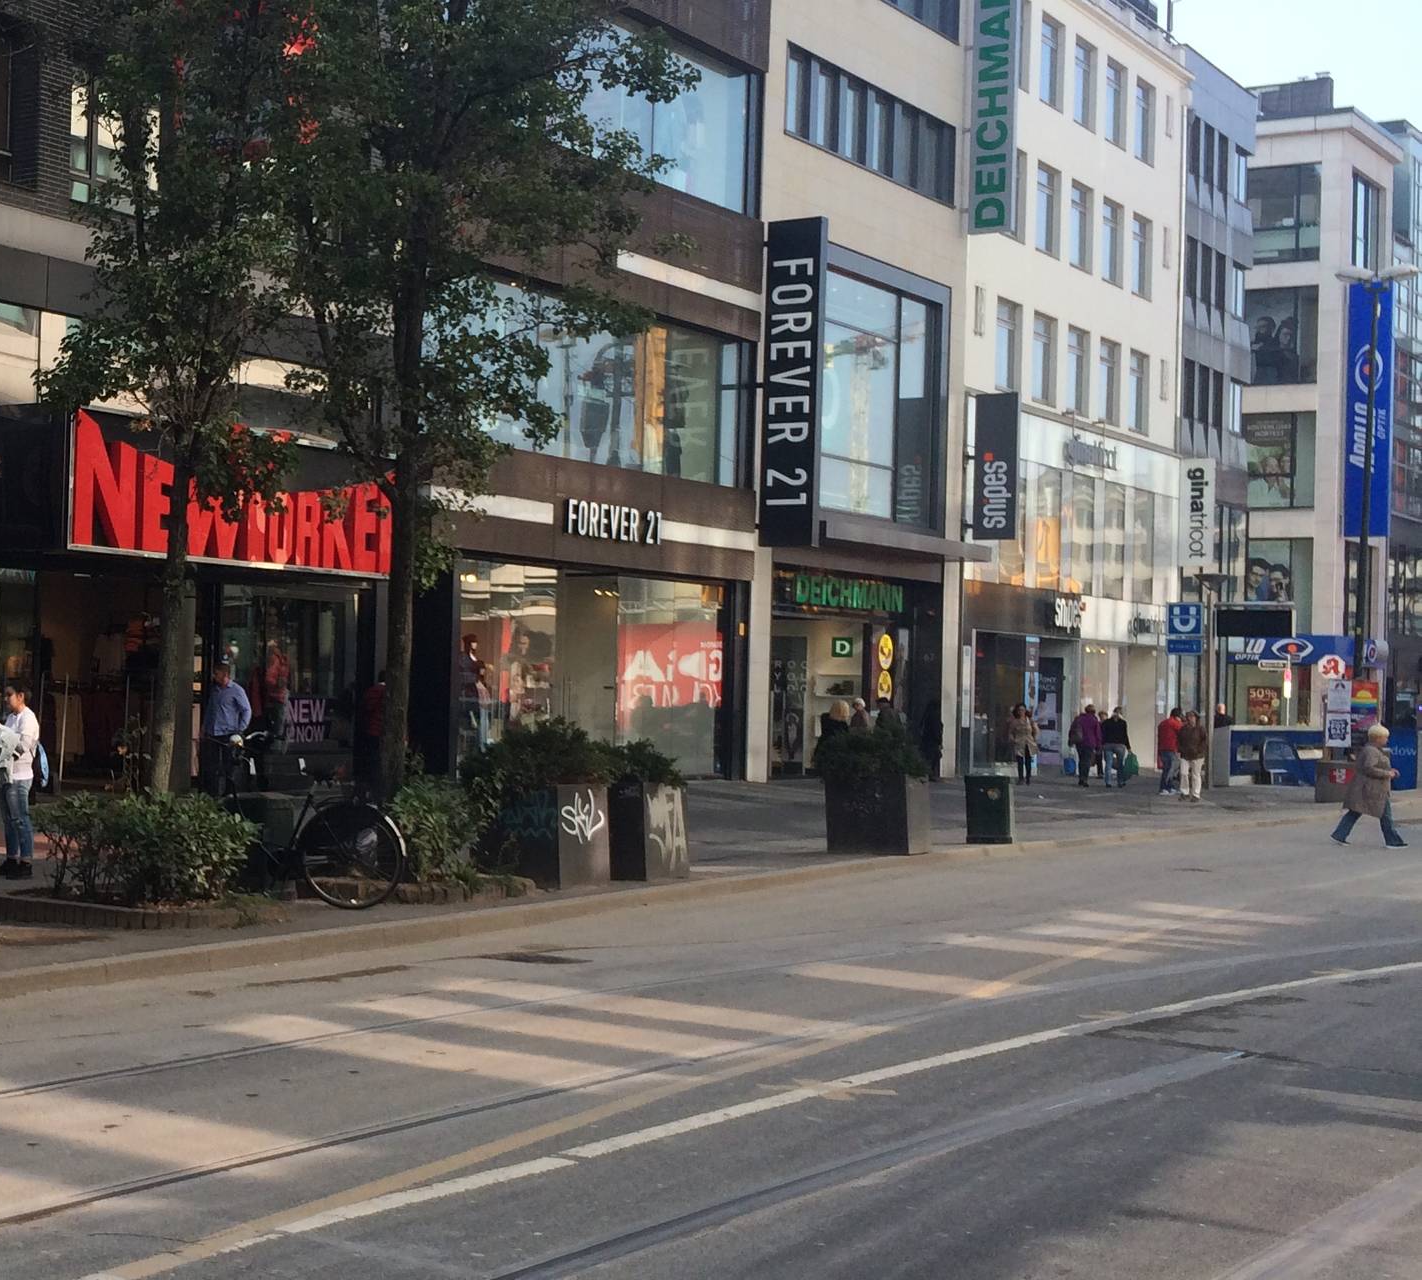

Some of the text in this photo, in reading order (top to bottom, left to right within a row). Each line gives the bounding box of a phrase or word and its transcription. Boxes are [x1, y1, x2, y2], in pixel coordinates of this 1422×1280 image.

[765, 257, 814, 506] FOREVER 21
[982, 460, 1012, 529] snipes
[1184, 467, 1208, 559] ginatricot
[568, 498, 663, 545] FOREVER 21
[795, 575, 903, 613] DEICHMANN
[286, 699, 326, 723] NEW
[1249, 688, 1277, 699] 50%
